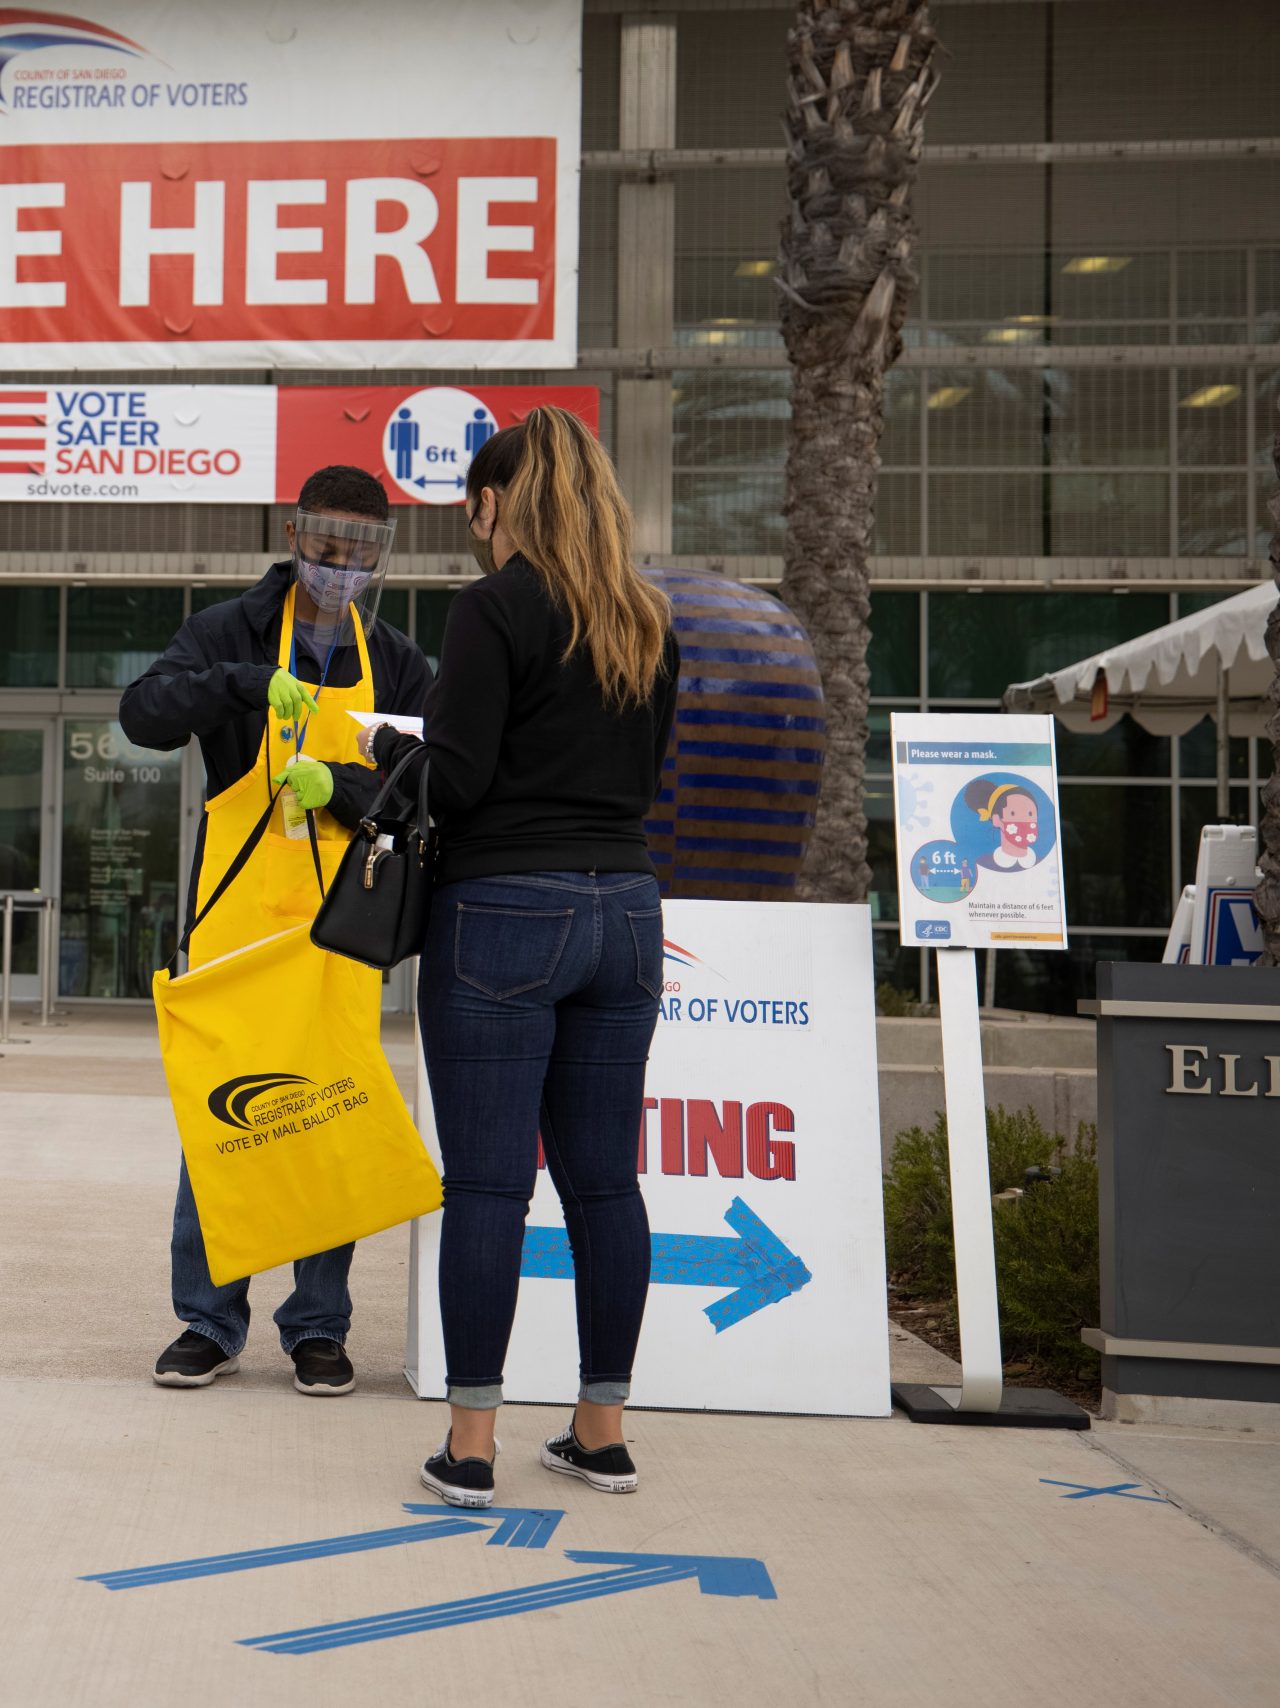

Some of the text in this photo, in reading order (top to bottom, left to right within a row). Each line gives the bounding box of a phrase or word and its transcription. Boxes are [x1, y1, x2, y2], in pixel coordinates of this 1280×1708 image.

[14, 67, 127, 80] COUNTY OF SAN DIEGO
[13, 82, 249, 109] REGISTRAR OF VOTERS
[119, 177, 539, 307] HERE
[56, 391, 147, 417] VOTE
[56, 420, 160, 446] SAFER
[55, 448, 241, 476] SAN DIEGO
[27, 480, 139, 497] sdvote.com
[911, 748, 998, 759] Please wear a mask.
[84, 766, 161, 783] Suite 100
[932, 850, 957, 865] 6 ft
[968, 902, 996, 910] Maintain
[688, 998, 718, 1022] OF
[724, 1000, 810, 1026] VOTERS
[251, 1100, 271, 1113] COUNTY
[272, 1098, 279, 1106] OF
[290, 1090, 306, 1100] DIEGO
[253, 1077, 356, 1127] REGISTRAR OF VOTERS
[216, 1091, 369, 1155] VOTE BY MAIL BALLOT BAG
